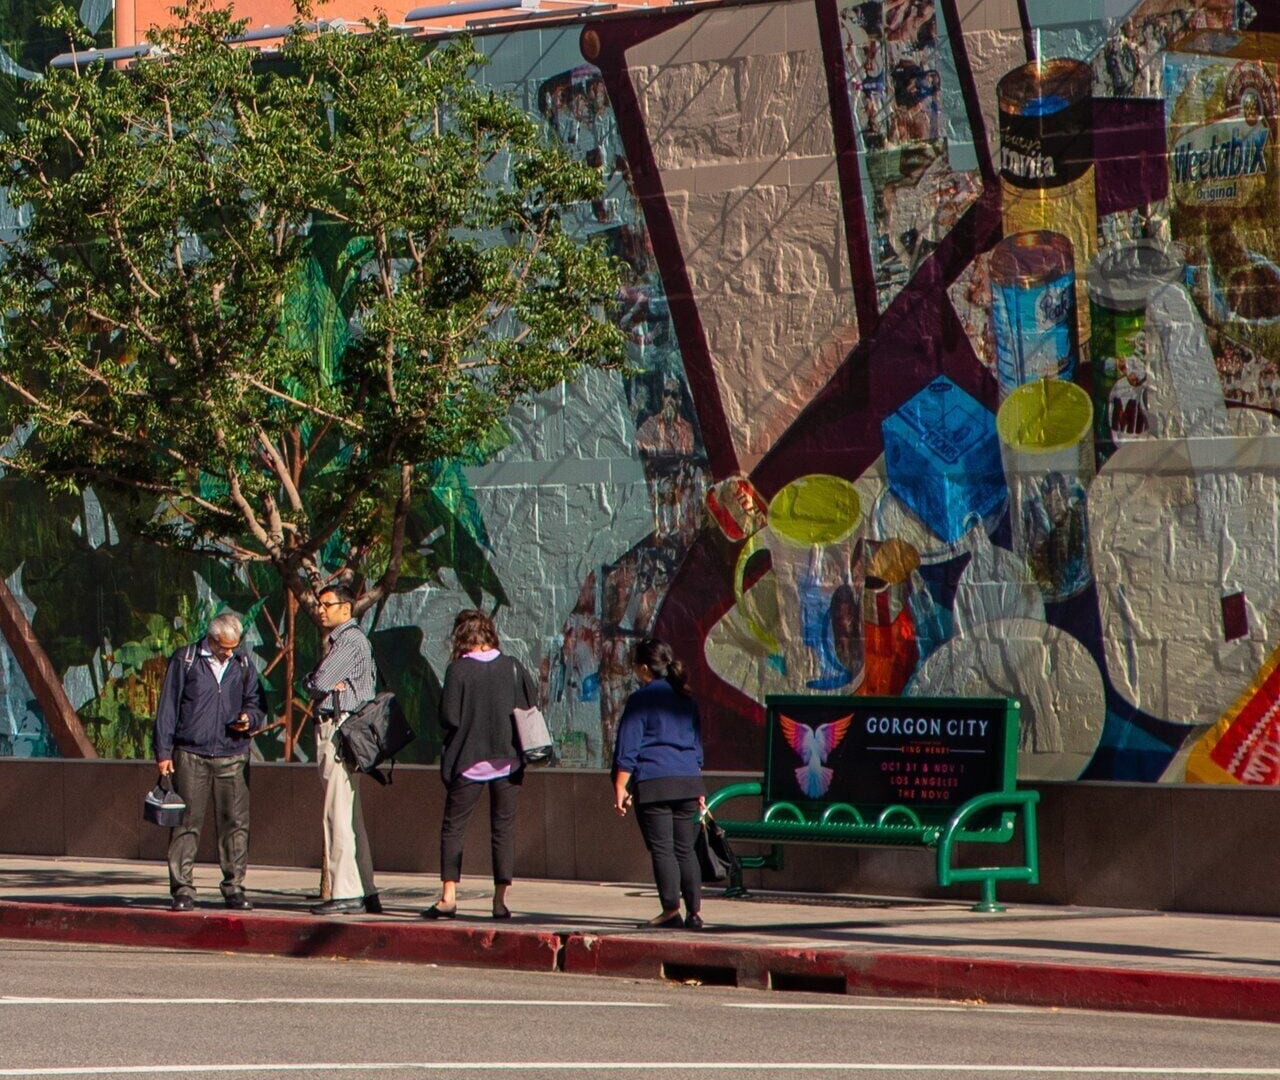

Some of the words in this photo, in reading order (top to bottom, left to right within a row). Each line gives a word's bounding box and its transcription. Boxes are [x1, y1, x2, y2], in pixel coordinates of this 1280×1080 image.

[1175, 128, 1269, 184] Weetabix
[1196, 182, 1237, 201] Original
[866, 717, 941, 736] GORGON
[947, 719, 989, 737] CITY
[881, 762, 900, 772] OCT
[934, 763, 956, 774] NOV
[890, 776, 908, 786] LOS
[914, 777, 958, 787] ANGELES
[898, 790, 915, 799] THE
[921, 790, 950, 800] NOVO
